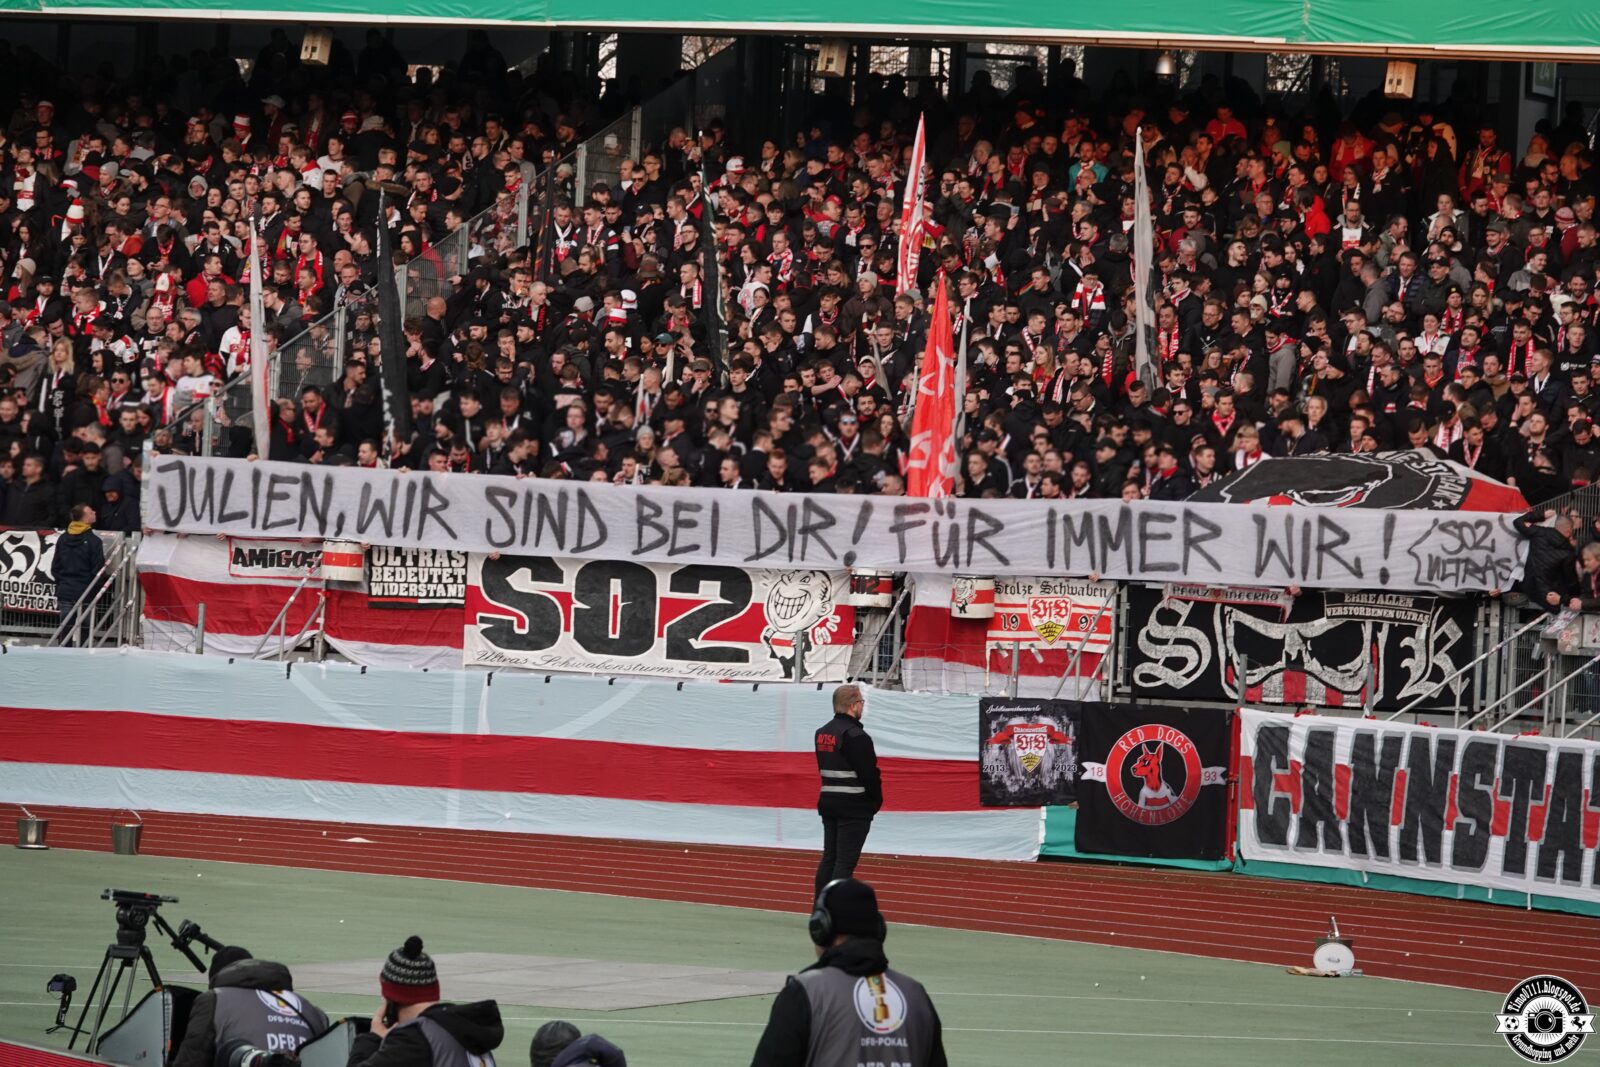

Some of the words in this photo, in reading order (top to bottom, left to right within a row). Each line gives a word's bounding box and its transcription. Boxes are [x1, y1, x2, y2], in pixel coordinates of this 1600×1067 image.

[157, 459, 346, 538] JULIEN,
[356, 476, 457, 541] WIR
[485, 486, 608, 554] SIND
[631, 495, 720, 558] BEI
[743, 497, 874, 566] DIR!
[889, 500, 1010, 569] FÜR
[1047, 507, 1222, 576] IMMER
[371, 547, 467, 567] ULTRAS
[371, 566, 466, 583] BEDEUTET
[370, 582, 465, 599] WIDERSTAND
[994, 580, 1033, 597] Stolze
[1040, 580, 1107, 598] Schwaben
[1344, 592, 1376, 604] EHRE
[1377, 594, 1414, 607] ALLEN
[1001, 614, 1019, 630] 19
[1326, 606, 1395, 618] VERSTORBENEN
[1396, 609, 1430, 623] ULTRAS
[475, 650, 529, 666] Ultras
[532, 654, 675, 674] Schwabensturm
[678, 663, 771, 679] Stuttgart
[1119, 729, 1145, 752] RED
[1157, 727, 1192, 754] DOGS
[983, 764, 1005, 773] 2013
[1055, 764, 1077, 773] 2023
[1091, 767, 1104, 778] 18
[1204, 771, 1217, 782] 93
[861, 1037, 908, 1047] DFB-POKAL
